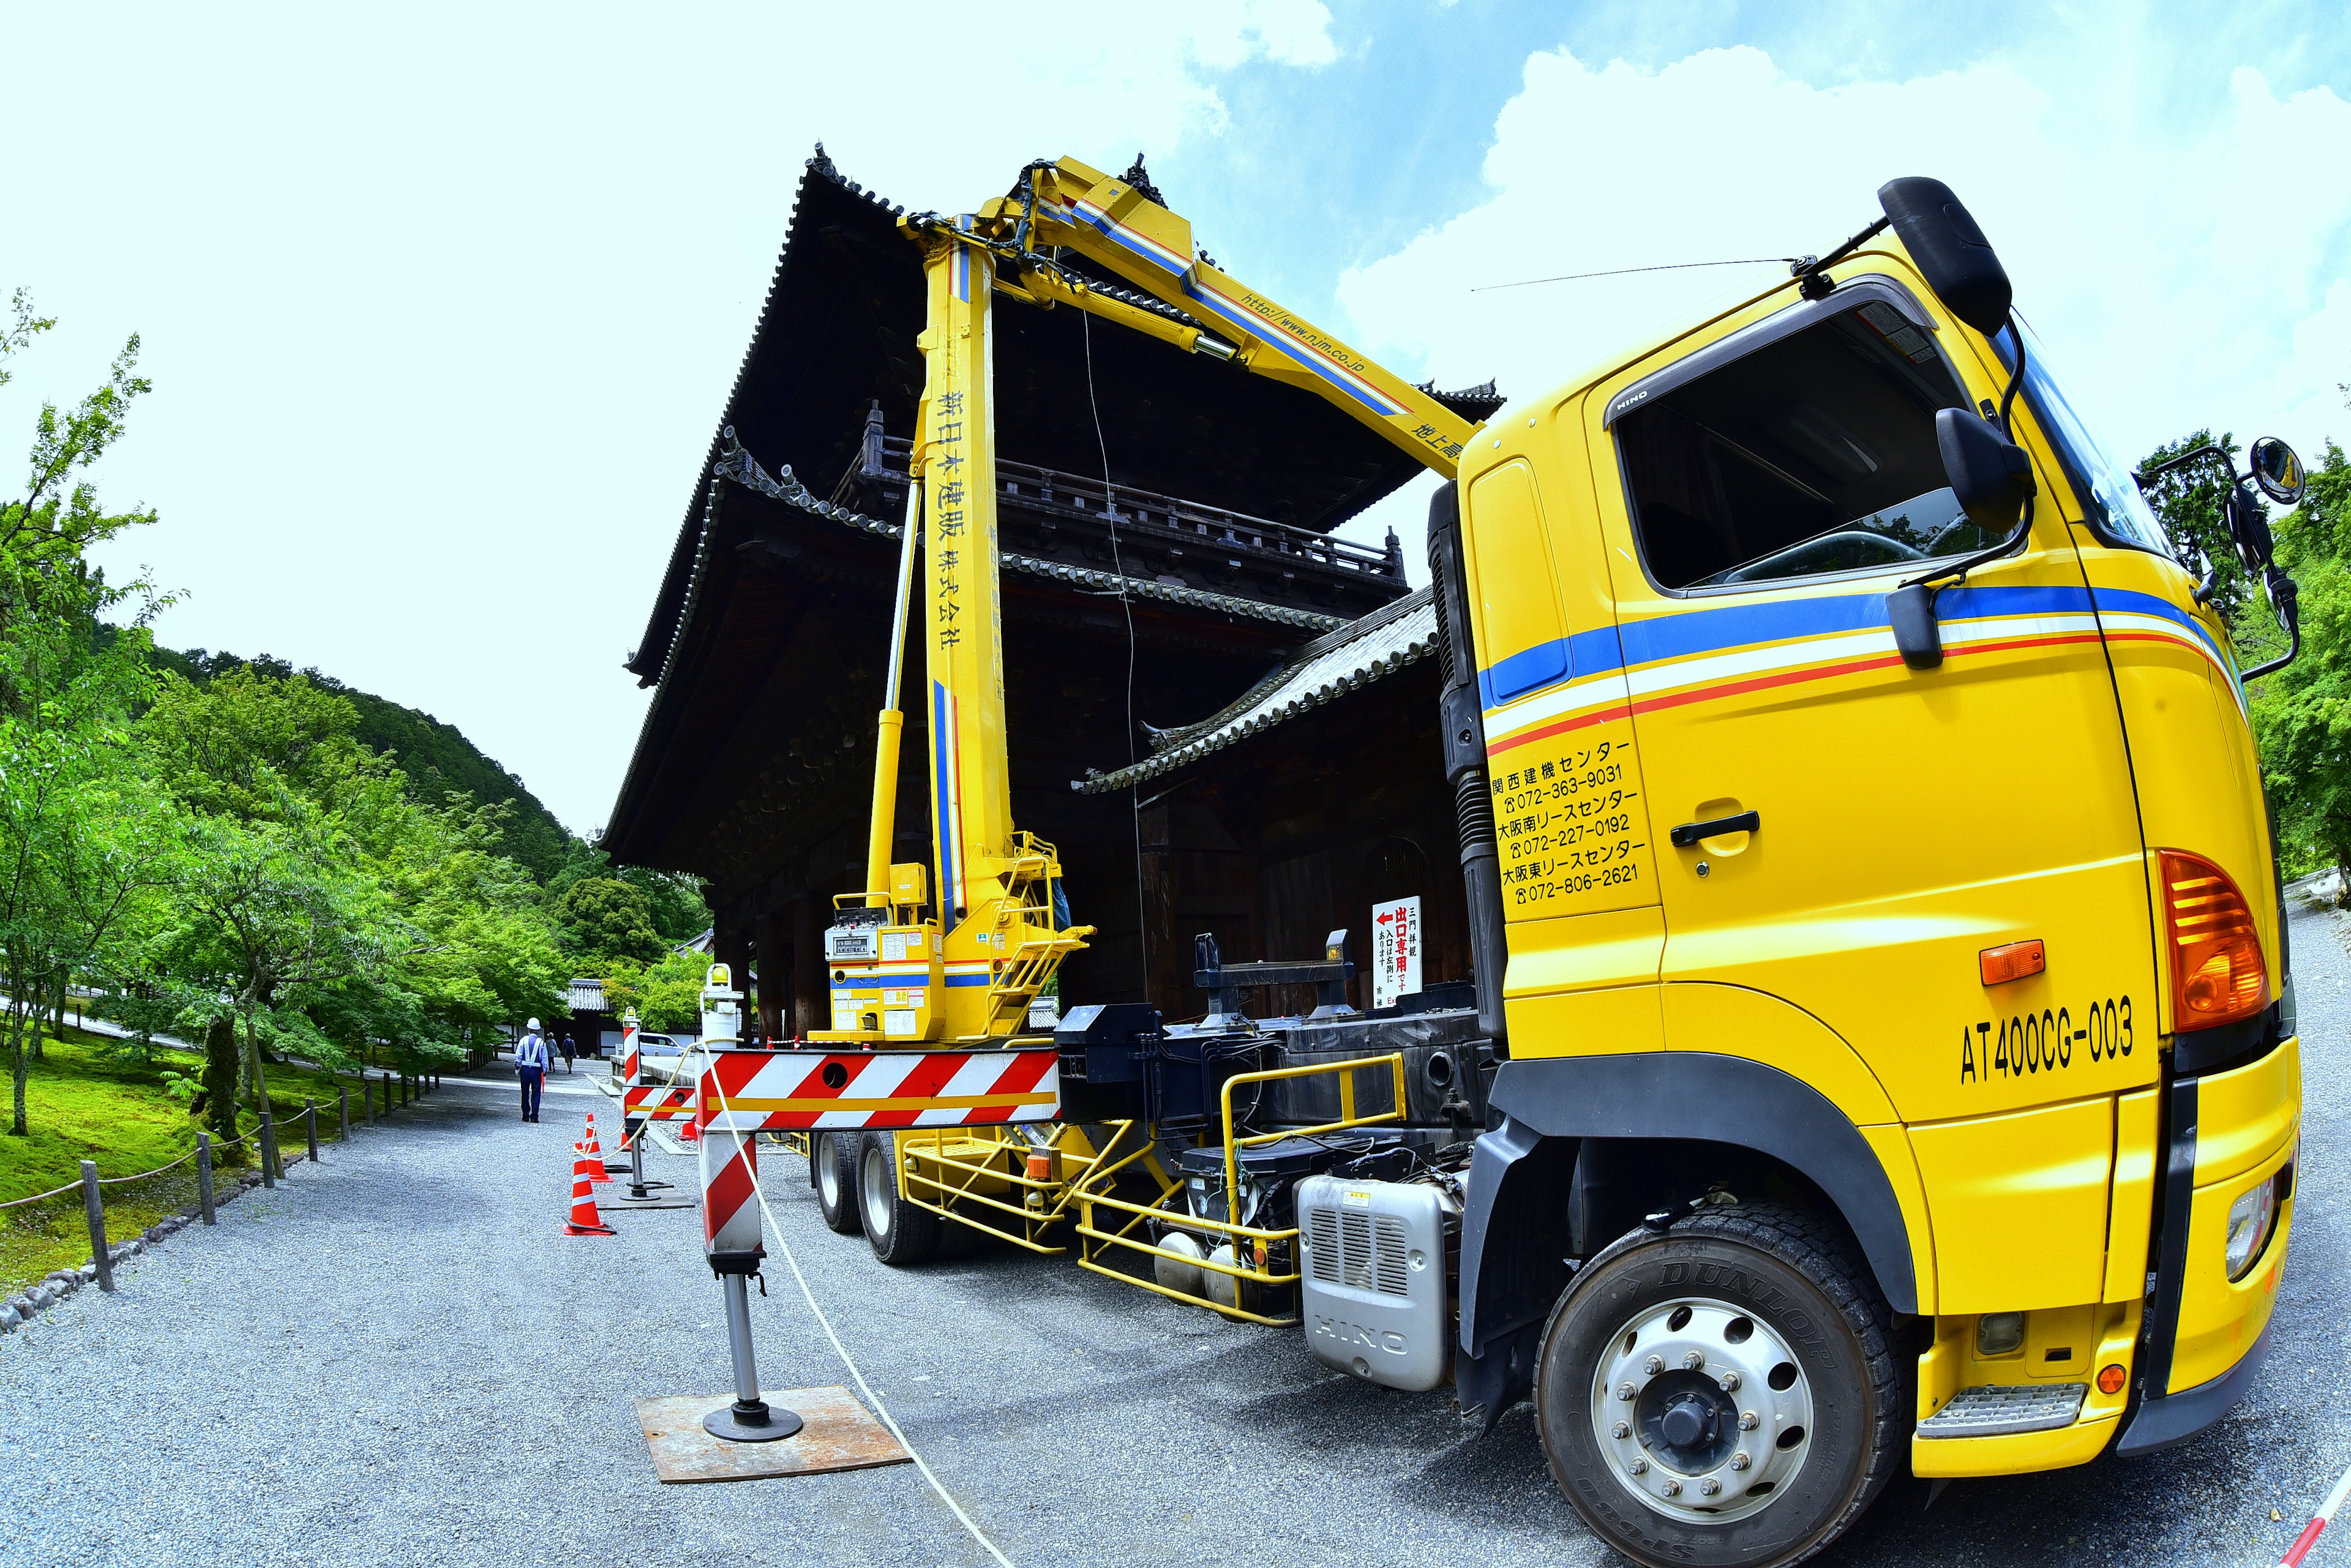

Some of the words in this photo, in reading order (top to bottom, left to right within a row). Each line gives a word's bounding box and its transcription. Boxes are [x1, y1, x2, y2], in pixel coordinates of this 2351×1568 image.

[1241, 294, 1366, 372] http://www.njm.co.jp
[1617, 391, 1648, 411] HINO
[1411, 423, 1464, 459] 地上高
[937, 390, 965, 651] 新日本建販株式会社
[1492, 741, 1629, 796] 関西建機センター
[1517, 763, 1622, 809] 072-363-9031
[1498, 790, 1638, 841] 大阪南リースセンター
[1524, 814, 1630, 855] 072-227-0192
[1502, 840, 1645, 886] 大阪東リースセンター
[1529, 863, 1638, 901] 072-806-2621
[1395, 906, 1408, 992] 出口専用です
[1408, 907, 1417, 958] 三門拝観
[1961, 995, 2133, 1085] AT400CG-003
[1314, 1315, 1409, 1356] HINO
[1659, 1261, 1838, 1370] DUNLOP
[1576, 1477, 1696, 1561] SP680
